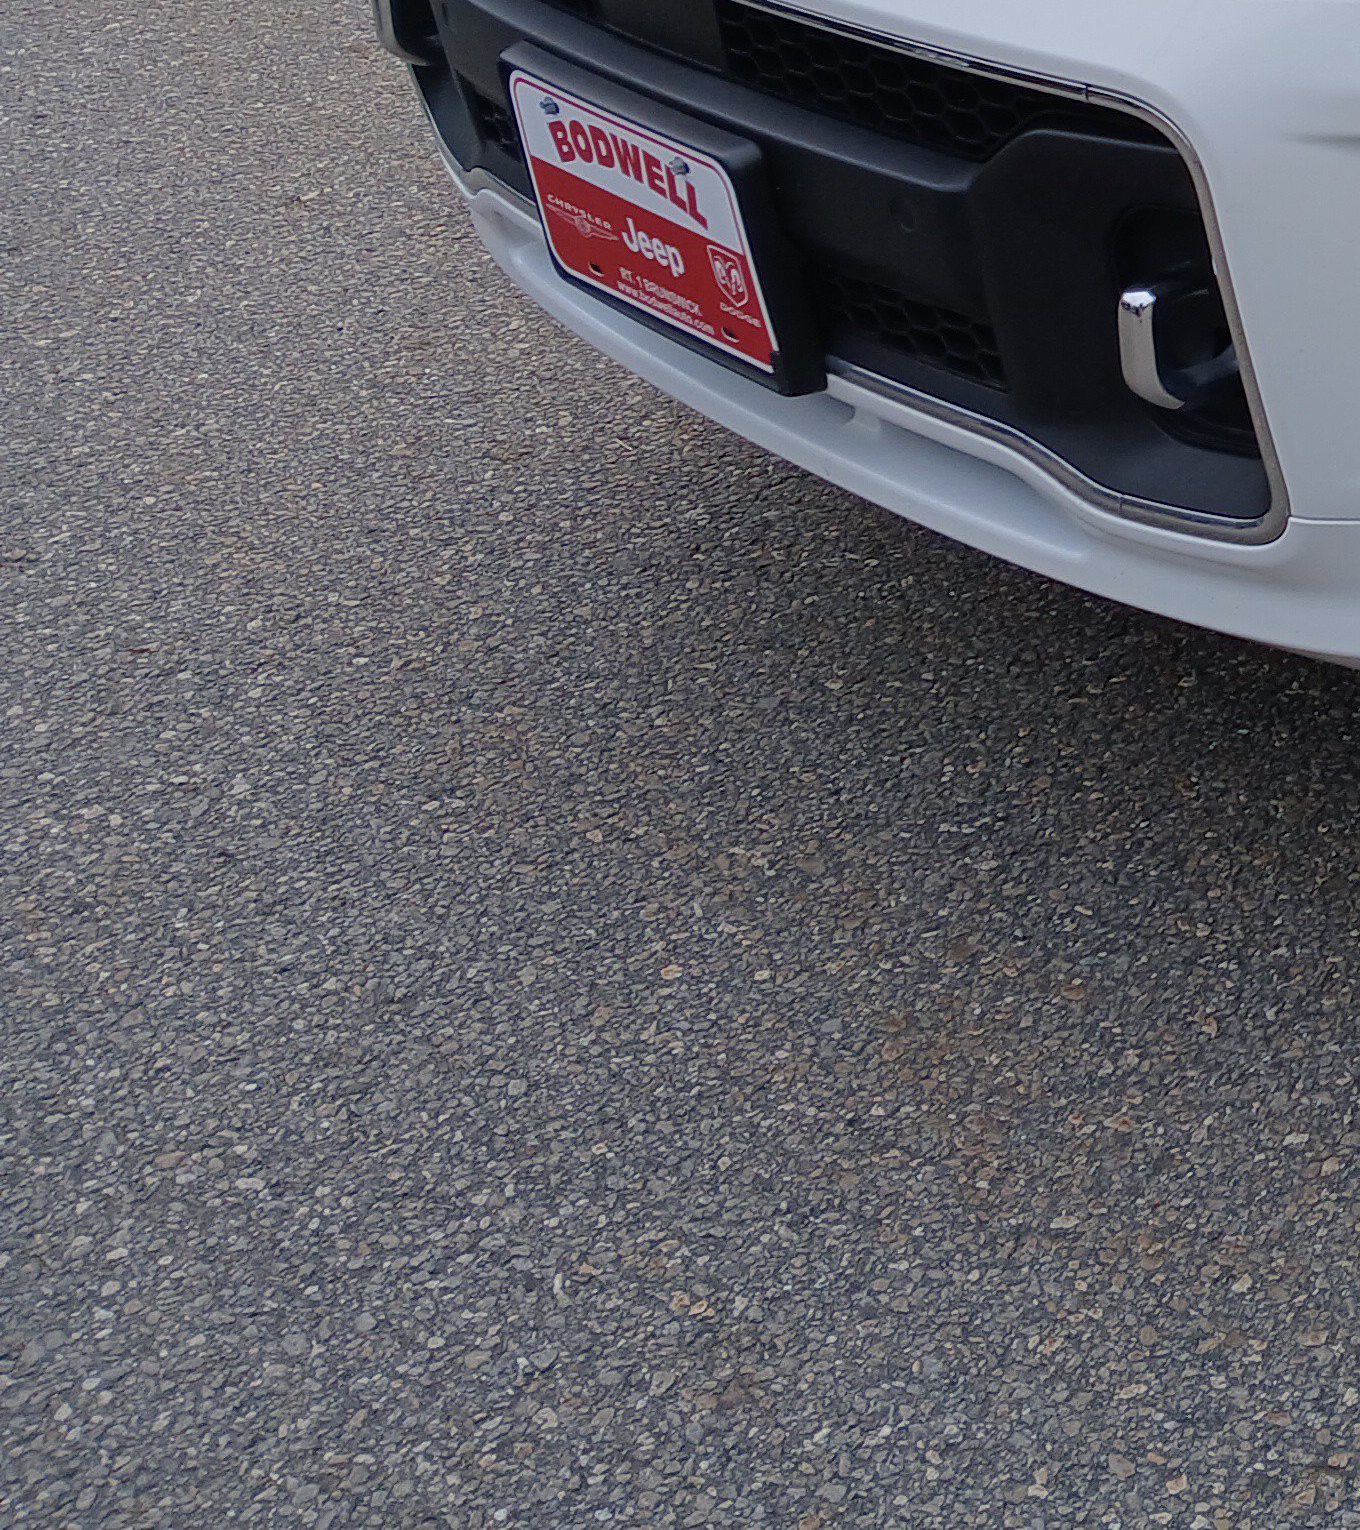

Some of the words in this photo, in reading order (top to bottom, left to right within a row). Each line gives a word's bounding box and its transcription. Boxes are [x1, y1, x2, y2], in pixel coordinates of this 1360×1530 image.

[547, 118, 709, 232] BODWELL
[546, 193, 614, 232] CHRYSLER
[620, 217, 686, 278] Jeep
